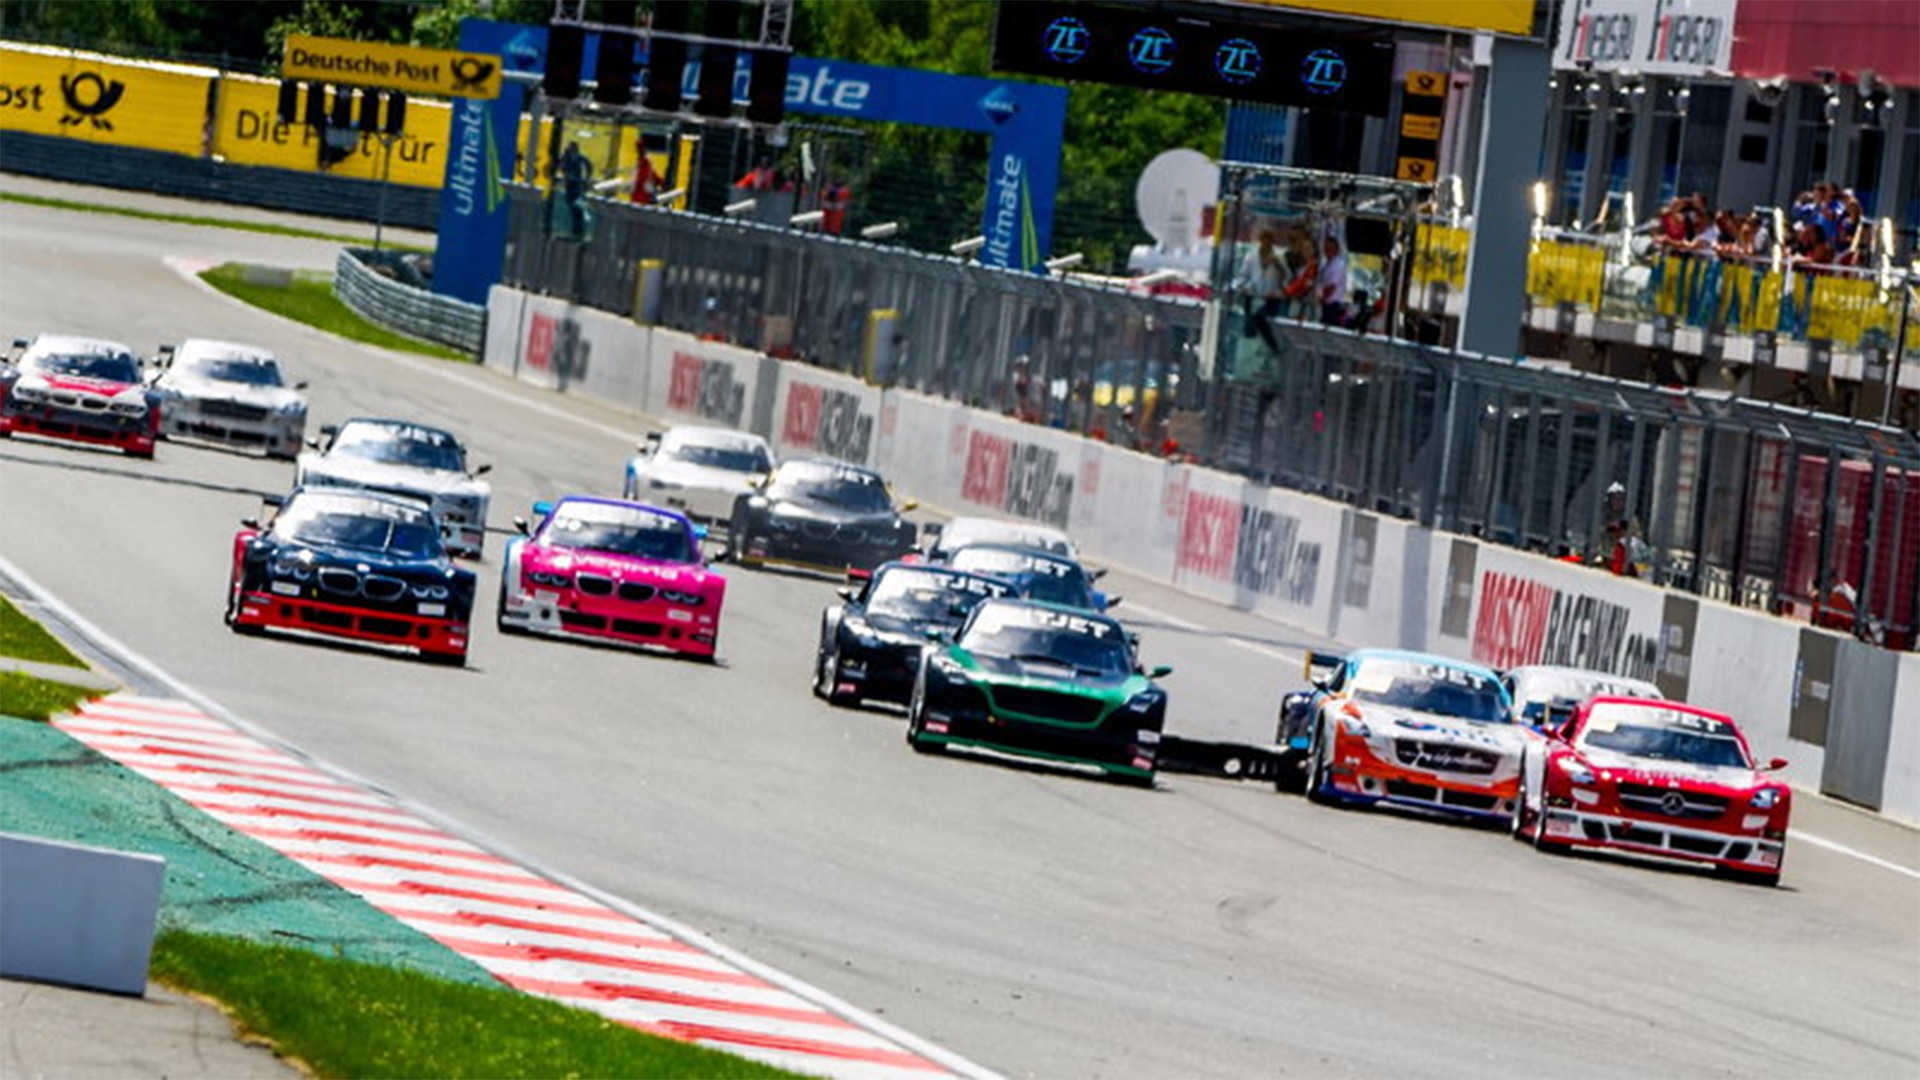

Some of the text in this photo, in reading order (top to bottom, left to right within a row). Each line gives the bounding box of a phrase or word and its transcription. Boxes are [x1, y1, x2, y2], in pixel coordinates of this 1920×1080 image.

[291, 48, 440, 83] Deutsche Post
[0, 83, 43, 111] ost
[235, 108, 290, 145] Die
[451, 99, 484, 215] ultimate
[835, 466, 875, 486] JET
[1021, 555, 1072, 578] JET
[937, 575, 1007, 600] TJET
[1037, 611, 1111, 639] TJET
[1416, 664, 1489, 690] TJET
[1666, 710, 1722, 733] JET
